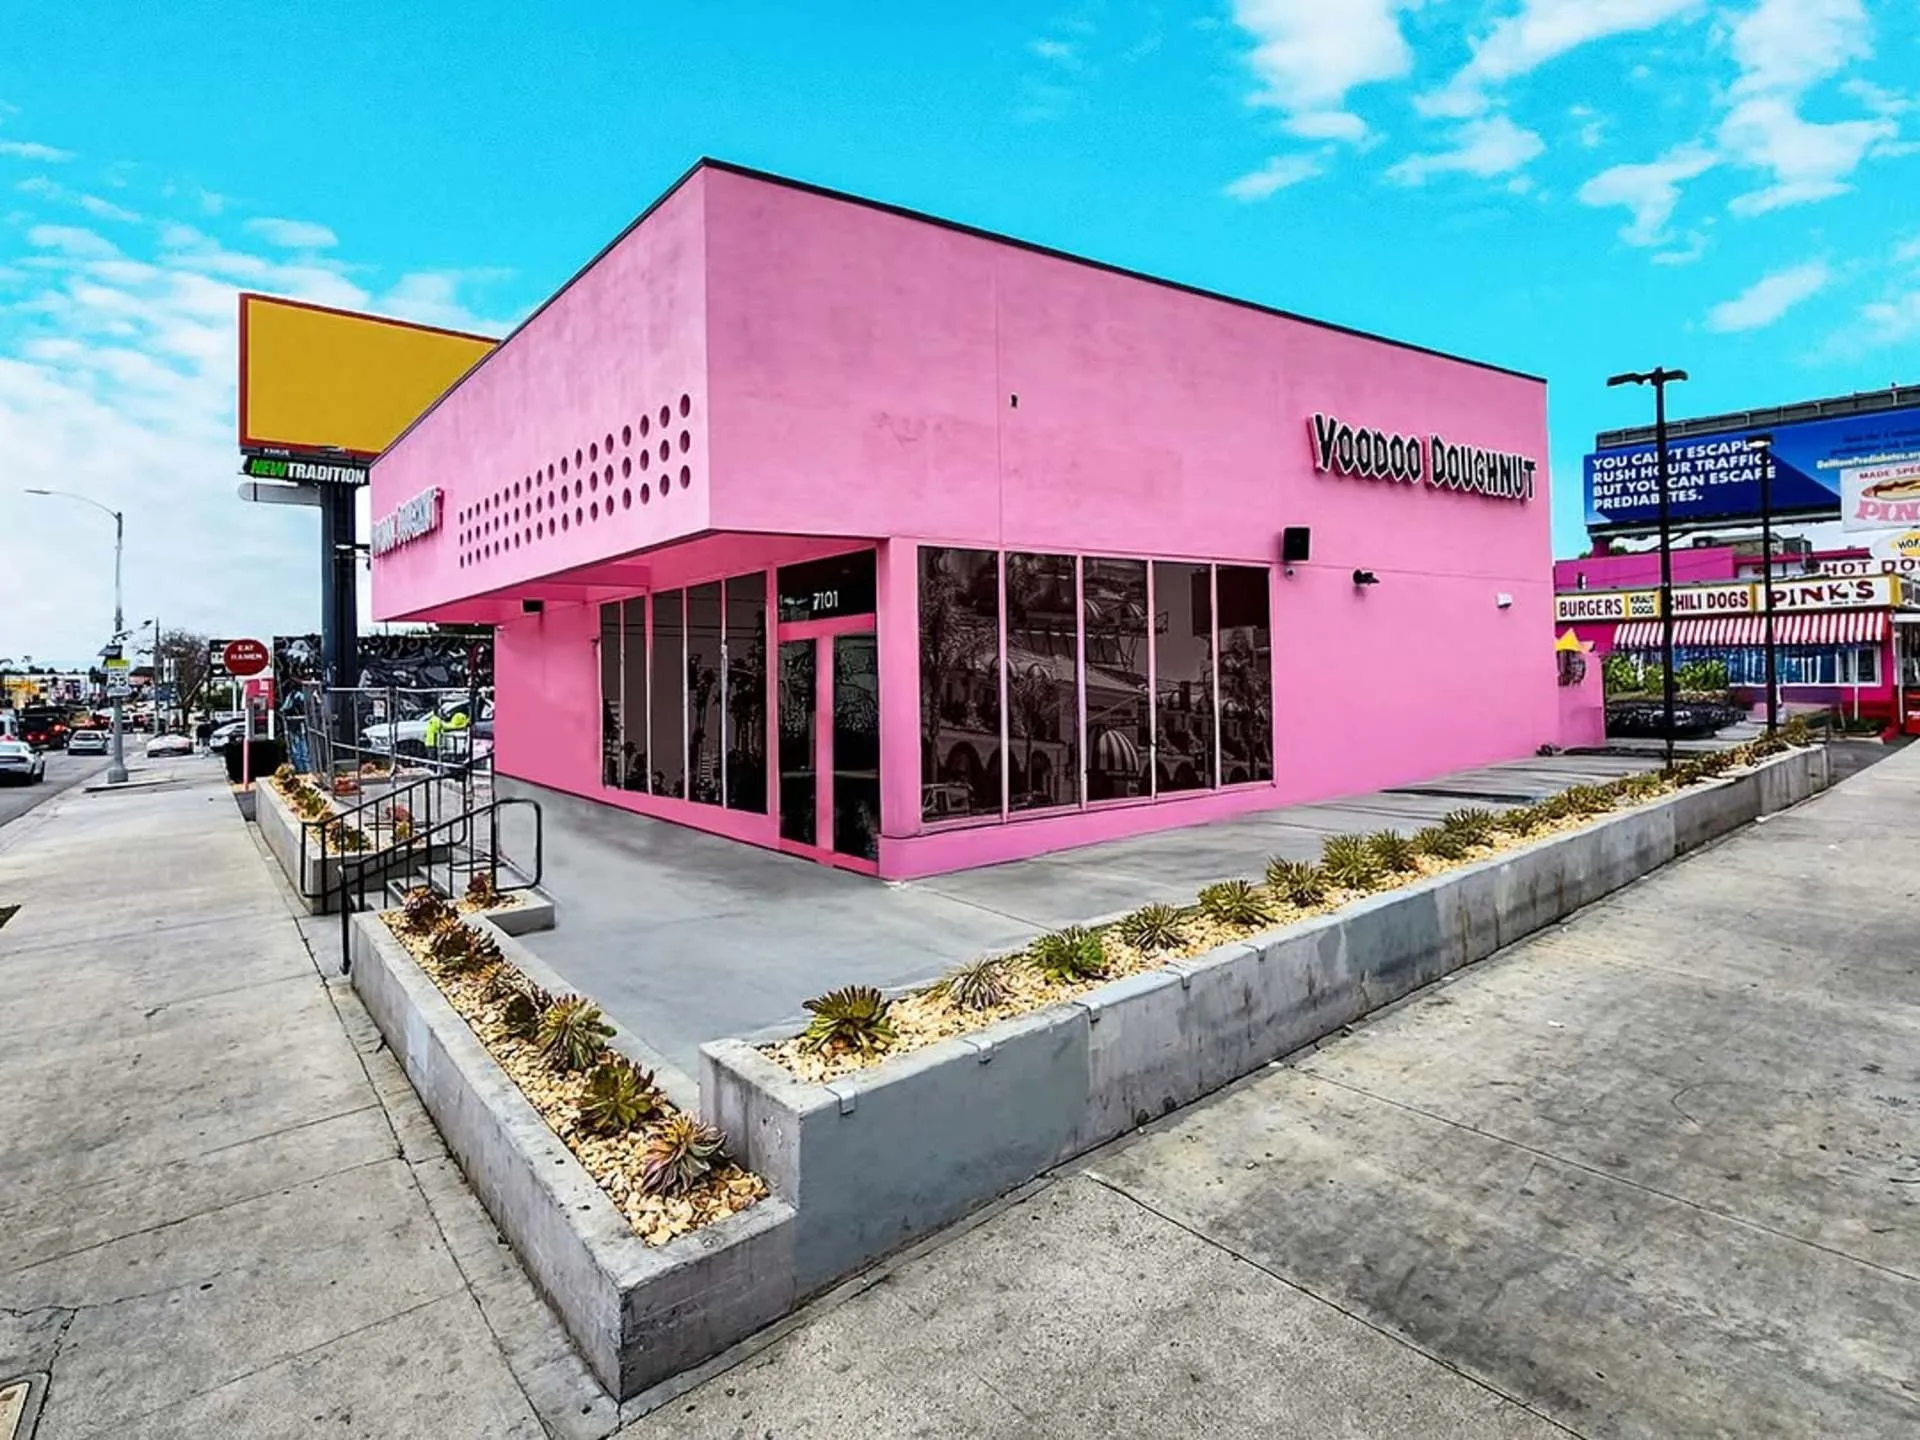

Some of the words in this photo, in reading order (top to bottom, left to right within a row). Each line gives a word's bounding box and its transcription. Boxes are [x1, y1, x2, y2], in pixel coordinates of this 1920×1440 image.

[1312, 412, 1422, 483] VOODOO
[1428, 433, 1536, 501] DOUGHNUT
[1592, 456, 1627, 470] YOU
[1592, 468, 1637, 484] RUSH
[1859, 470, 1889, 479] MADE
[1593, 483, 1624, 497] BUT
[1666, 474, 1705, 489] CAN
[1592, 488, 1703, 511] PREDIABTES.
[1824, 561, 1870, 575] HOT
[1881, 558, 1920, 574] DO
[812, 590, 838, 610] 7101
[1707, 591, 1749, 609] DOGS
[1770, 580, 1875, 608] PINK'S
[1559, 598, 1623, 619] BURGERS
